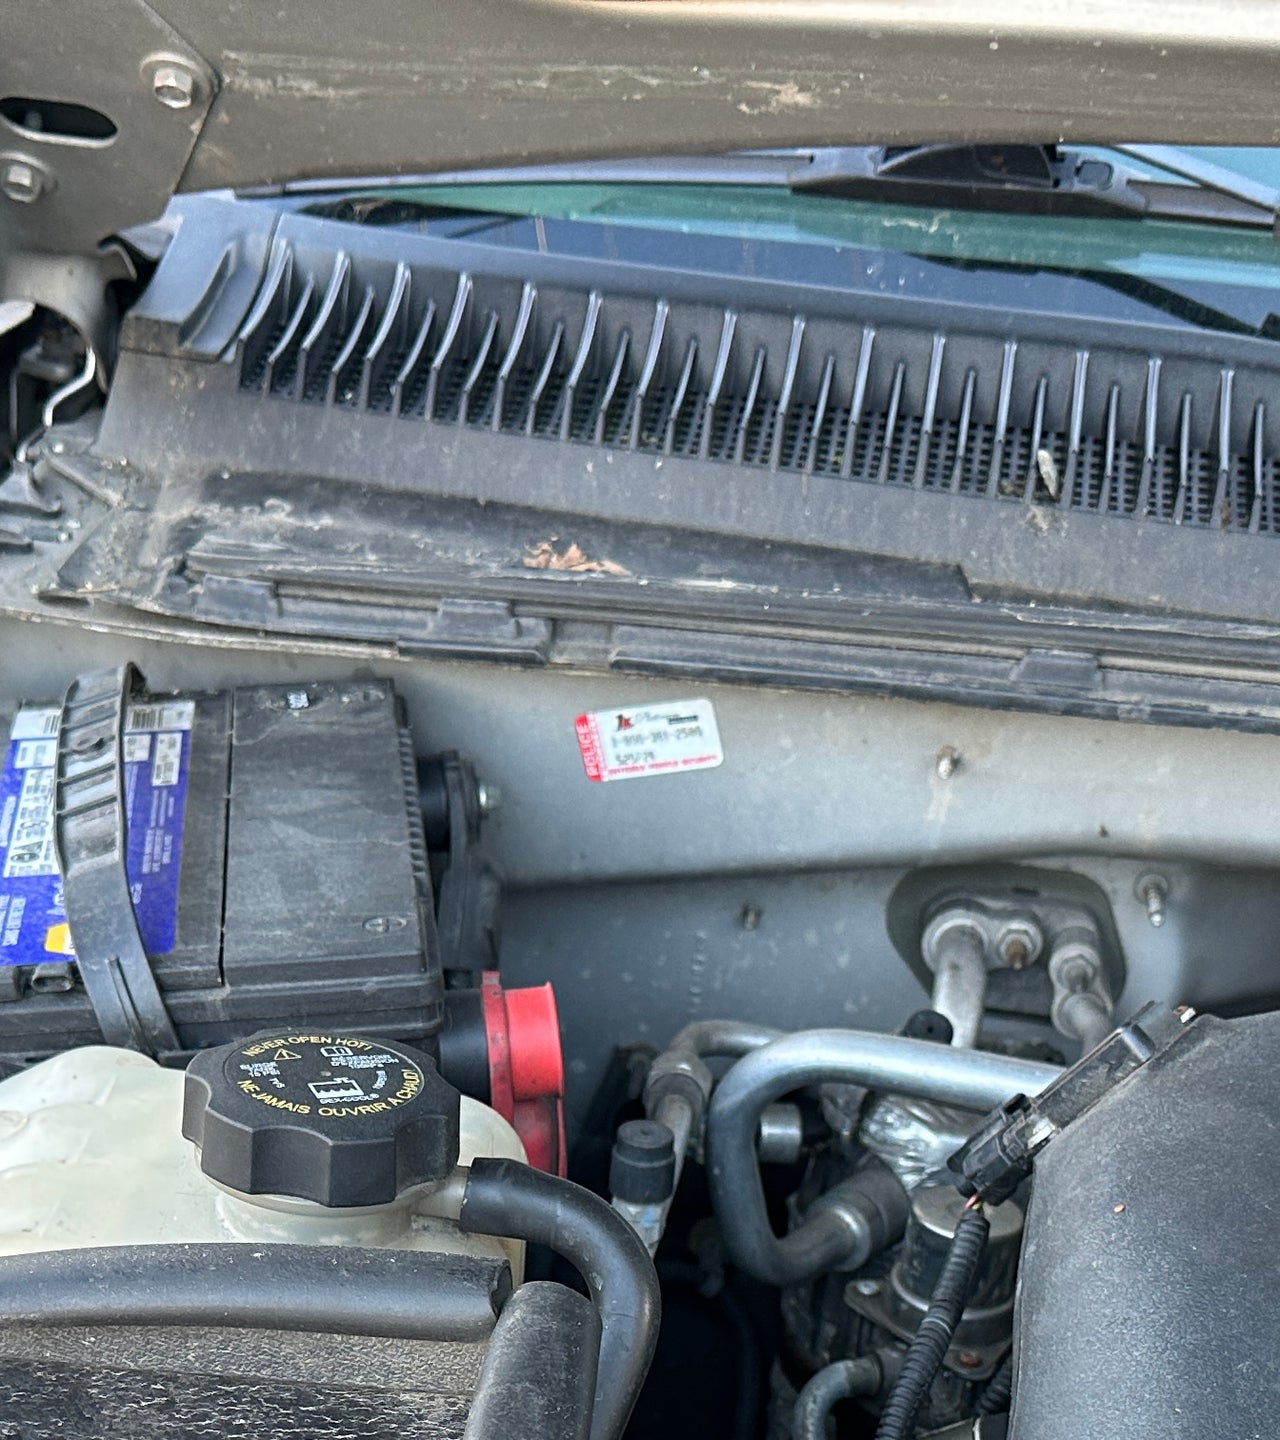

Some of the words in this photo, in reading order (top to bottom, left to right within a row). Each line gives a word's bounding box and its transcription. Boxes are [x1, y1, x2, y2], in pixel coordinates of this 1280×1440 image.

[576, 720, 600, 777] POLICE
[241, 1038, 290, 1056] NEVER
[288, 1036, 332, 1044] OPEN
[335, 1038, 373, 1051] HOT!
[237, 1080, 261, 1093] NE
[251, 1092, 311, 1114] JAMAIS
[318, 1102, 392, 1117] OUVRIR
[396, 1068, 421, 1099] CHAUD!
